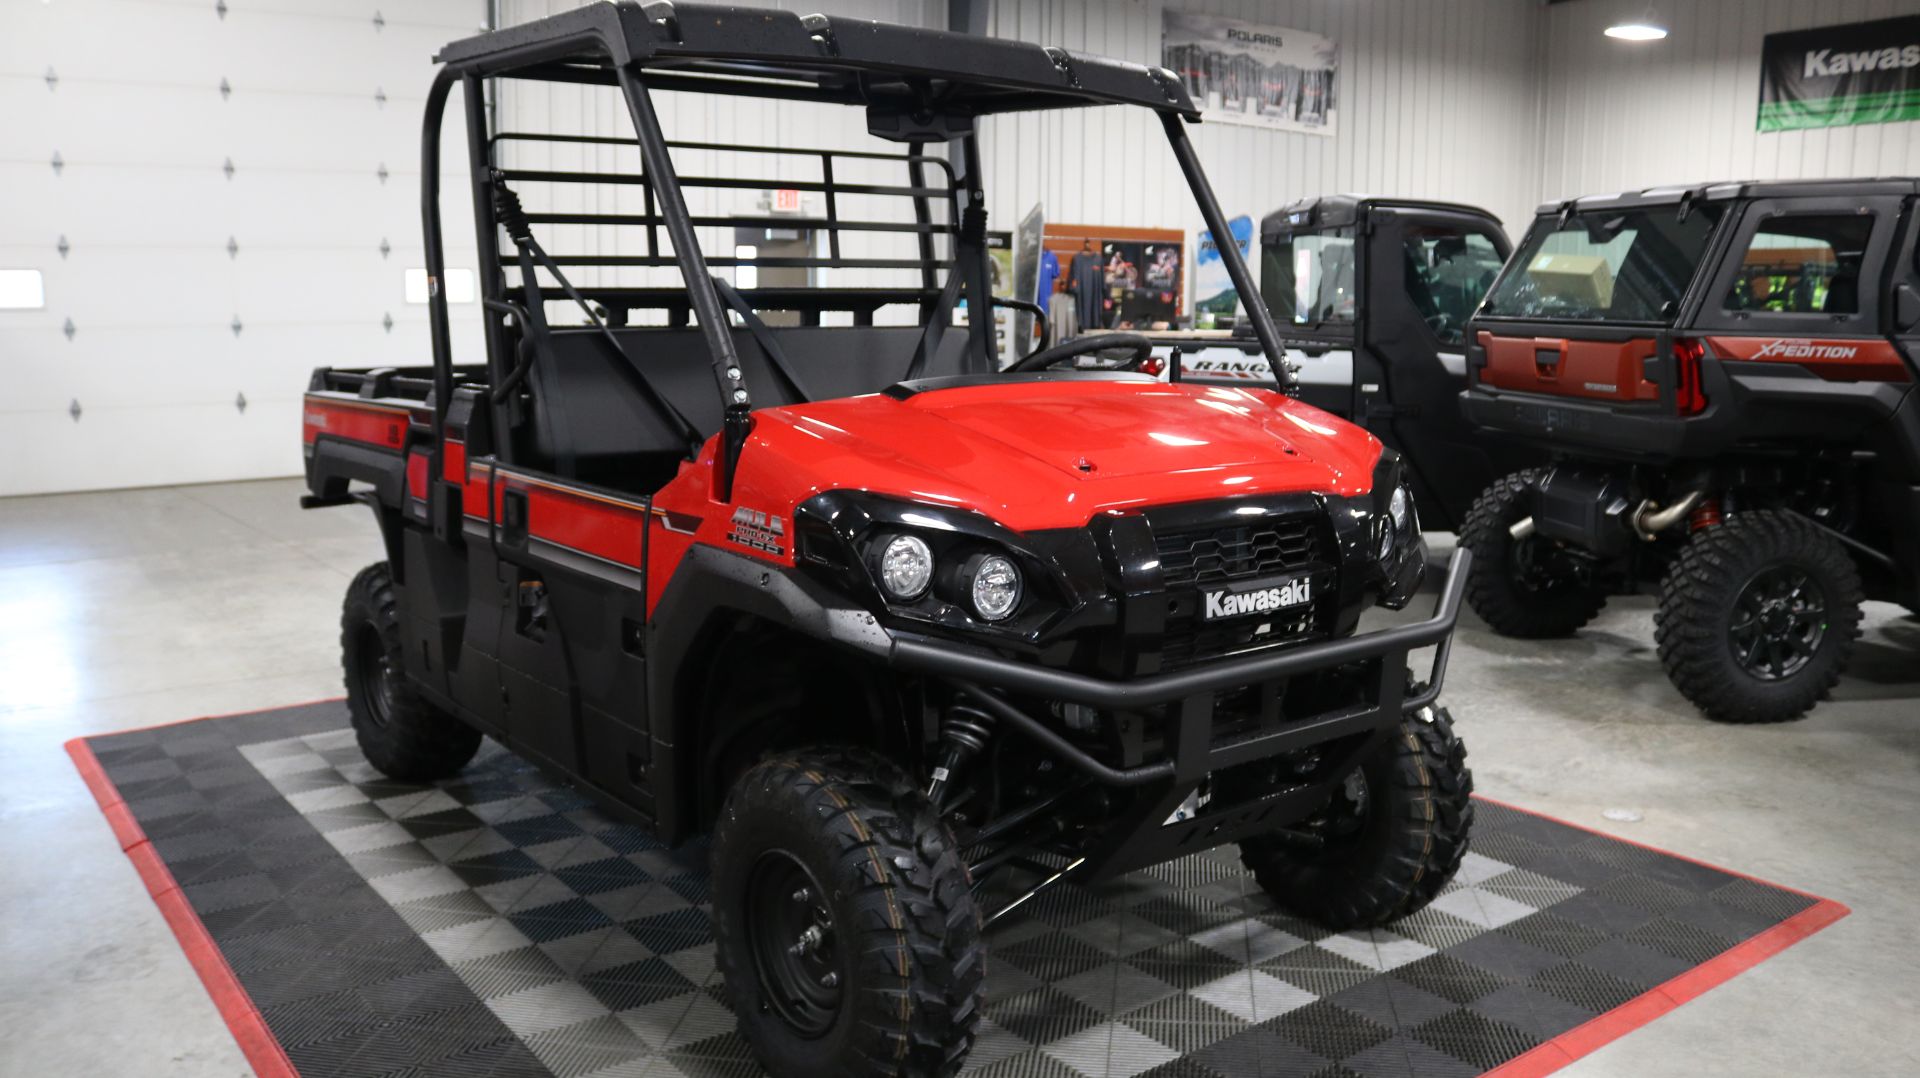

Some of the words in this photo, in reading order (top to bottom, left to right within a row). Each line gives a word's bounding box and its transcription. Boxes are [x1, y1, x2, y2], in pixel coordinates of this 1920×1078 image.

[1227, 28, 1283, 48] POLARIS
[1804, 44, 1920, 78] Kawas
[1750, 340, 1857, 360] XPEDITION
[1206, 577, 1310, 619] Kawasaki
